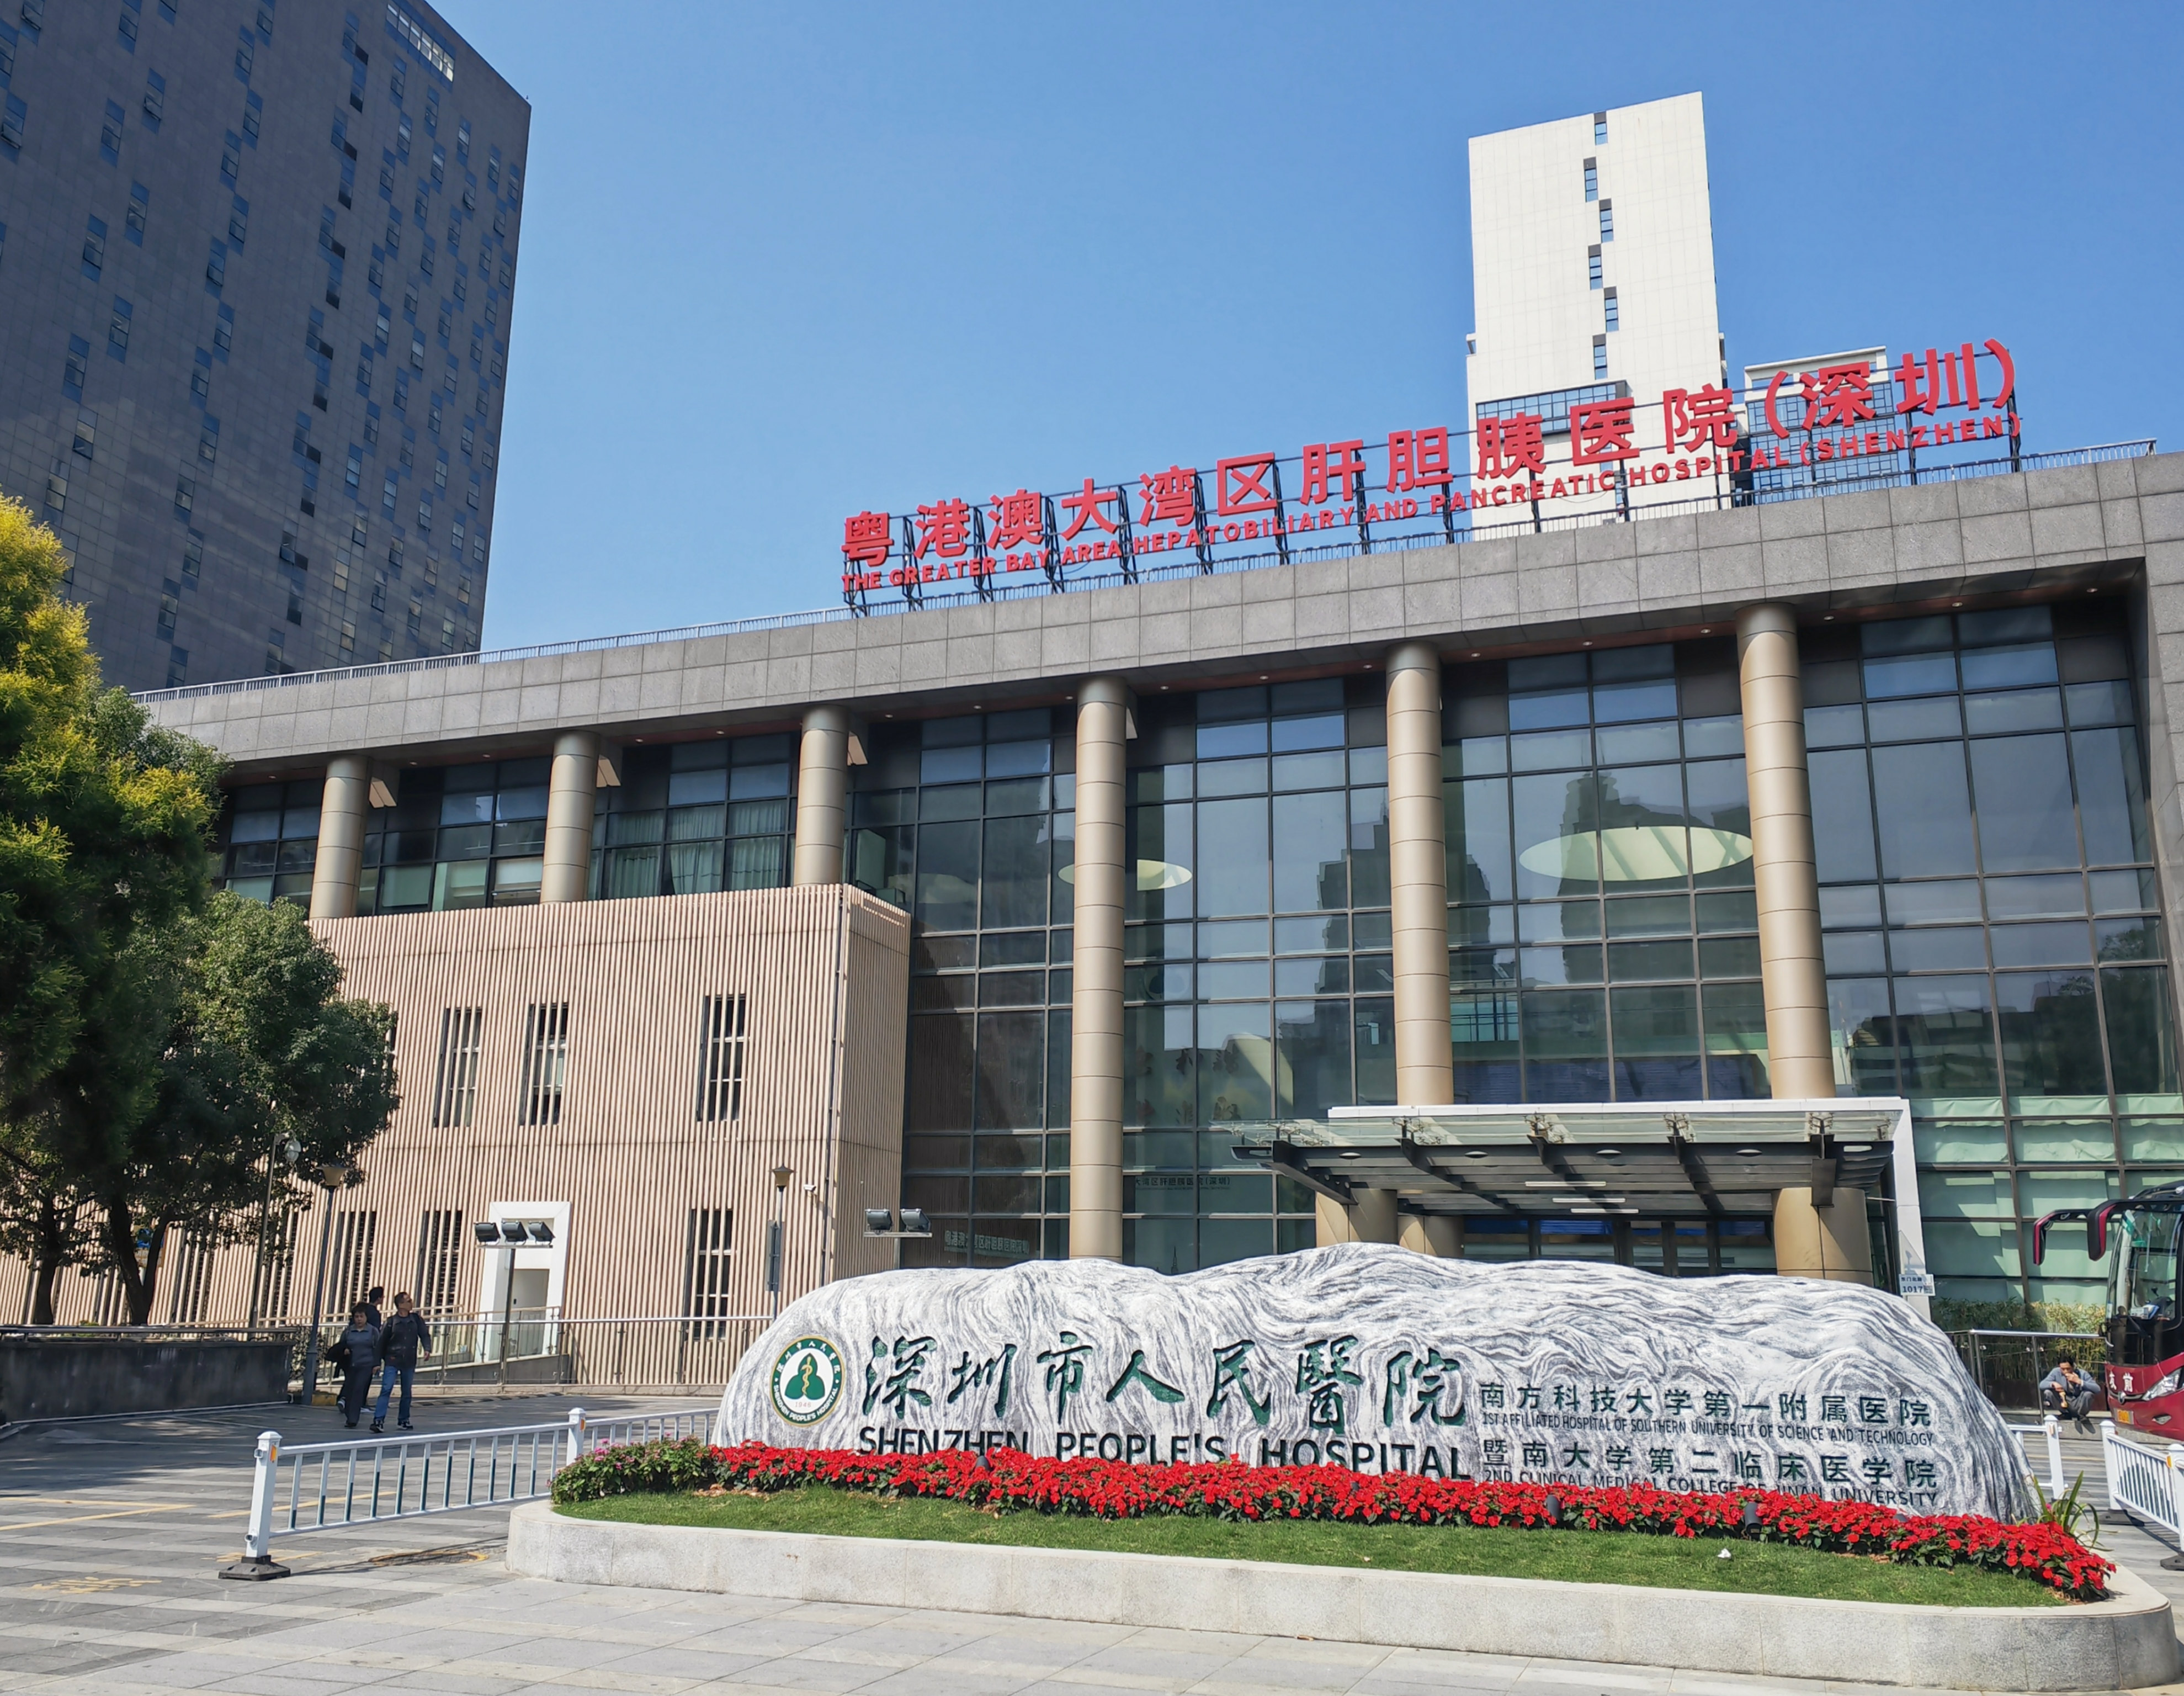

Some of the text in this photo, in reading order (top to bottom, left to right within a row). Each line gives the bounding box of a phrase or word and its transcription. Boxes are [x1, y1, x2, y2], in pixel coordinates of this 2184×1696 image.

[842, 412, 2021, 592] THE GREATER BAY AREA HEPATOBILIARY AND PANCREATIC HOSPITAL (SHENZHEN)
[773, 1385, 789, 1416] SHENZHEN
[816, 1387, 838, 1417] HOSPITAL
[1480, 1382, 1931, 1426] 南方科技大学第一附属医院
[1482, 1412, 1934, 1446] 1ST AFFILIATED HOSPITAL OF SOUTHERN UNIVERSITY OF SCIENCE AND TECHNOLOGY
[859, 1426, 1472, 1480] SHENZHEN PEOPLE'S HOSPITAL
[1484, 1439, 1936, 1488] 暨南大学第二临床医学院
[1485, 1470, 1512, 1482] 2ND
[1520, 1471, 1586, 1487] CLINICAL
[1667, 1477, 1737, 1493] COLLEGE
[1832, 1488, 1937, 1506] UNIVERSITY
